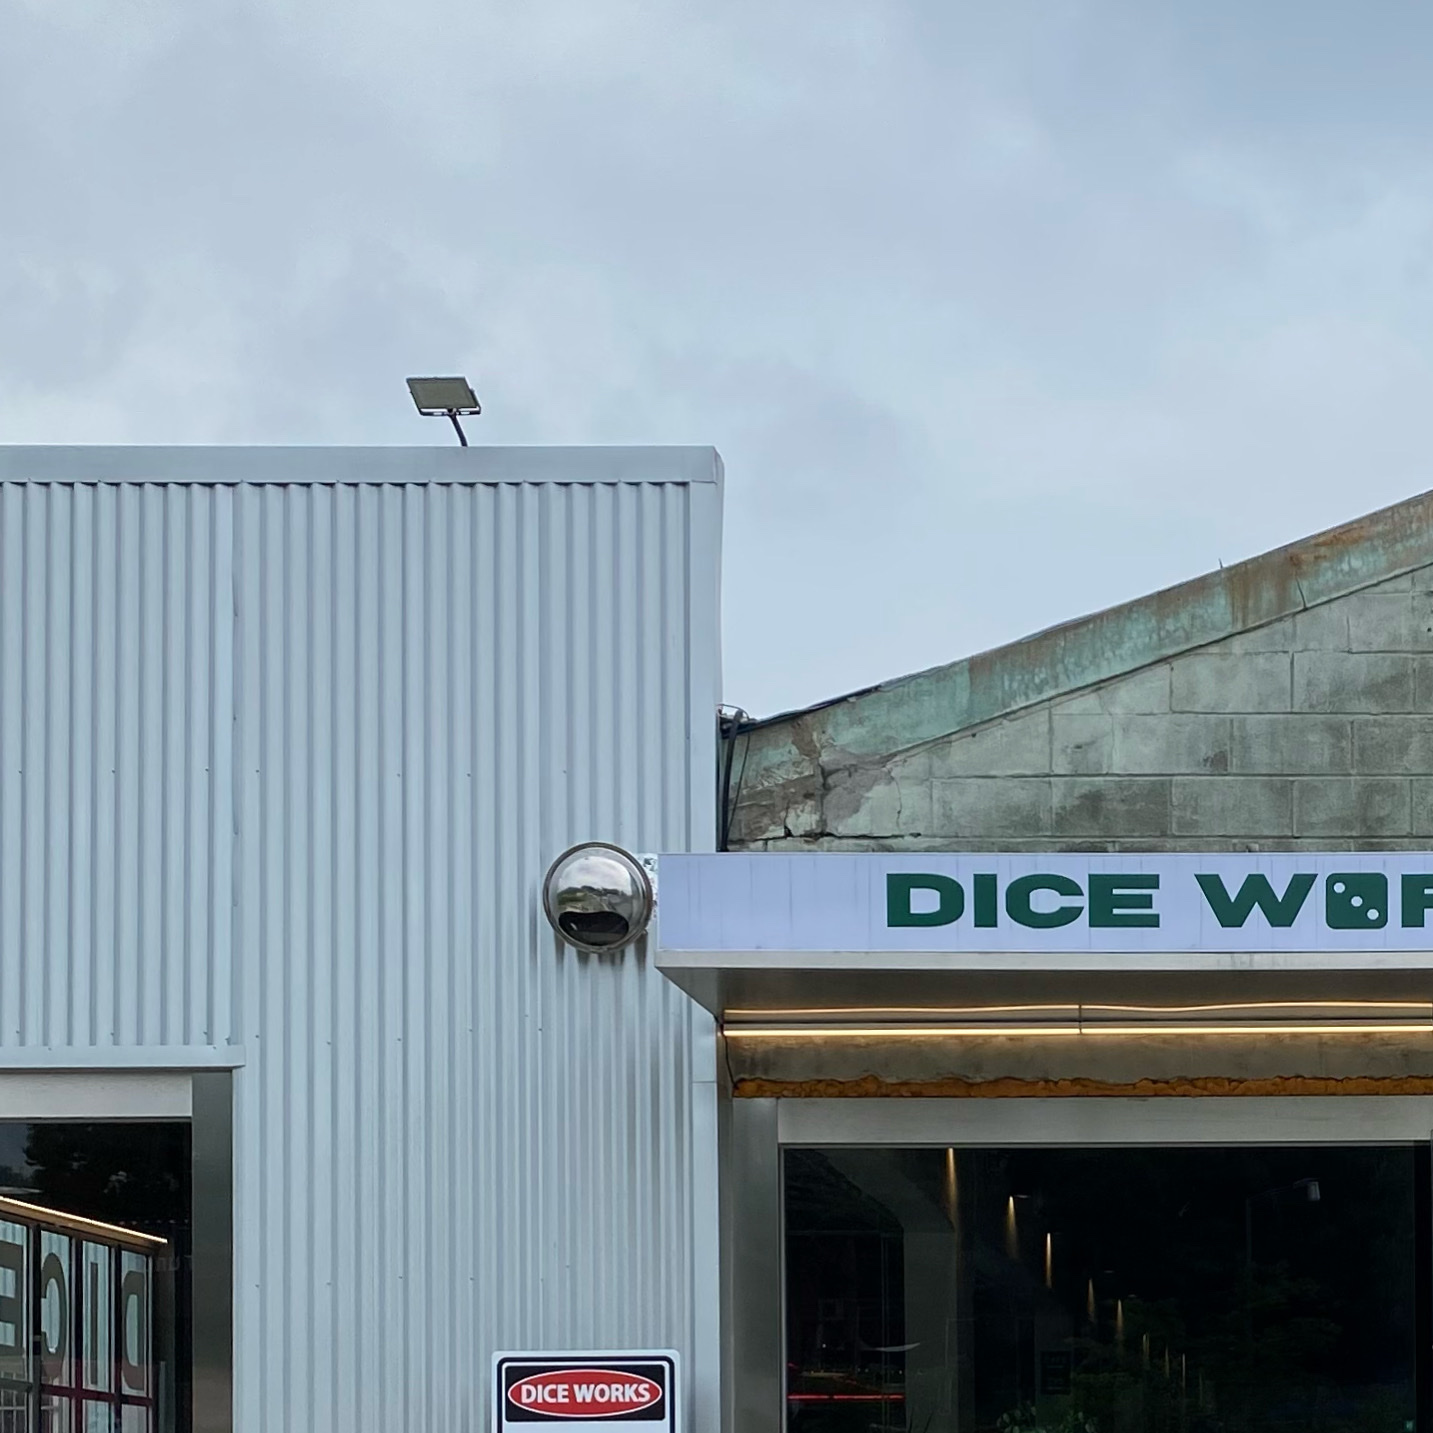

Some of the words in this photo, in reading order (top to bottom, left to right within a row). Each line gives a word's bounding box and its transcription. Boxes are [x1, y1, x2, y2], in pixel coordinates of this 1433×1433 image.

[886, 873, 1160, 928] DICE
[521, 1384, 568, 1404] DICE
[573, 1382, 651, 1404] WORKS
